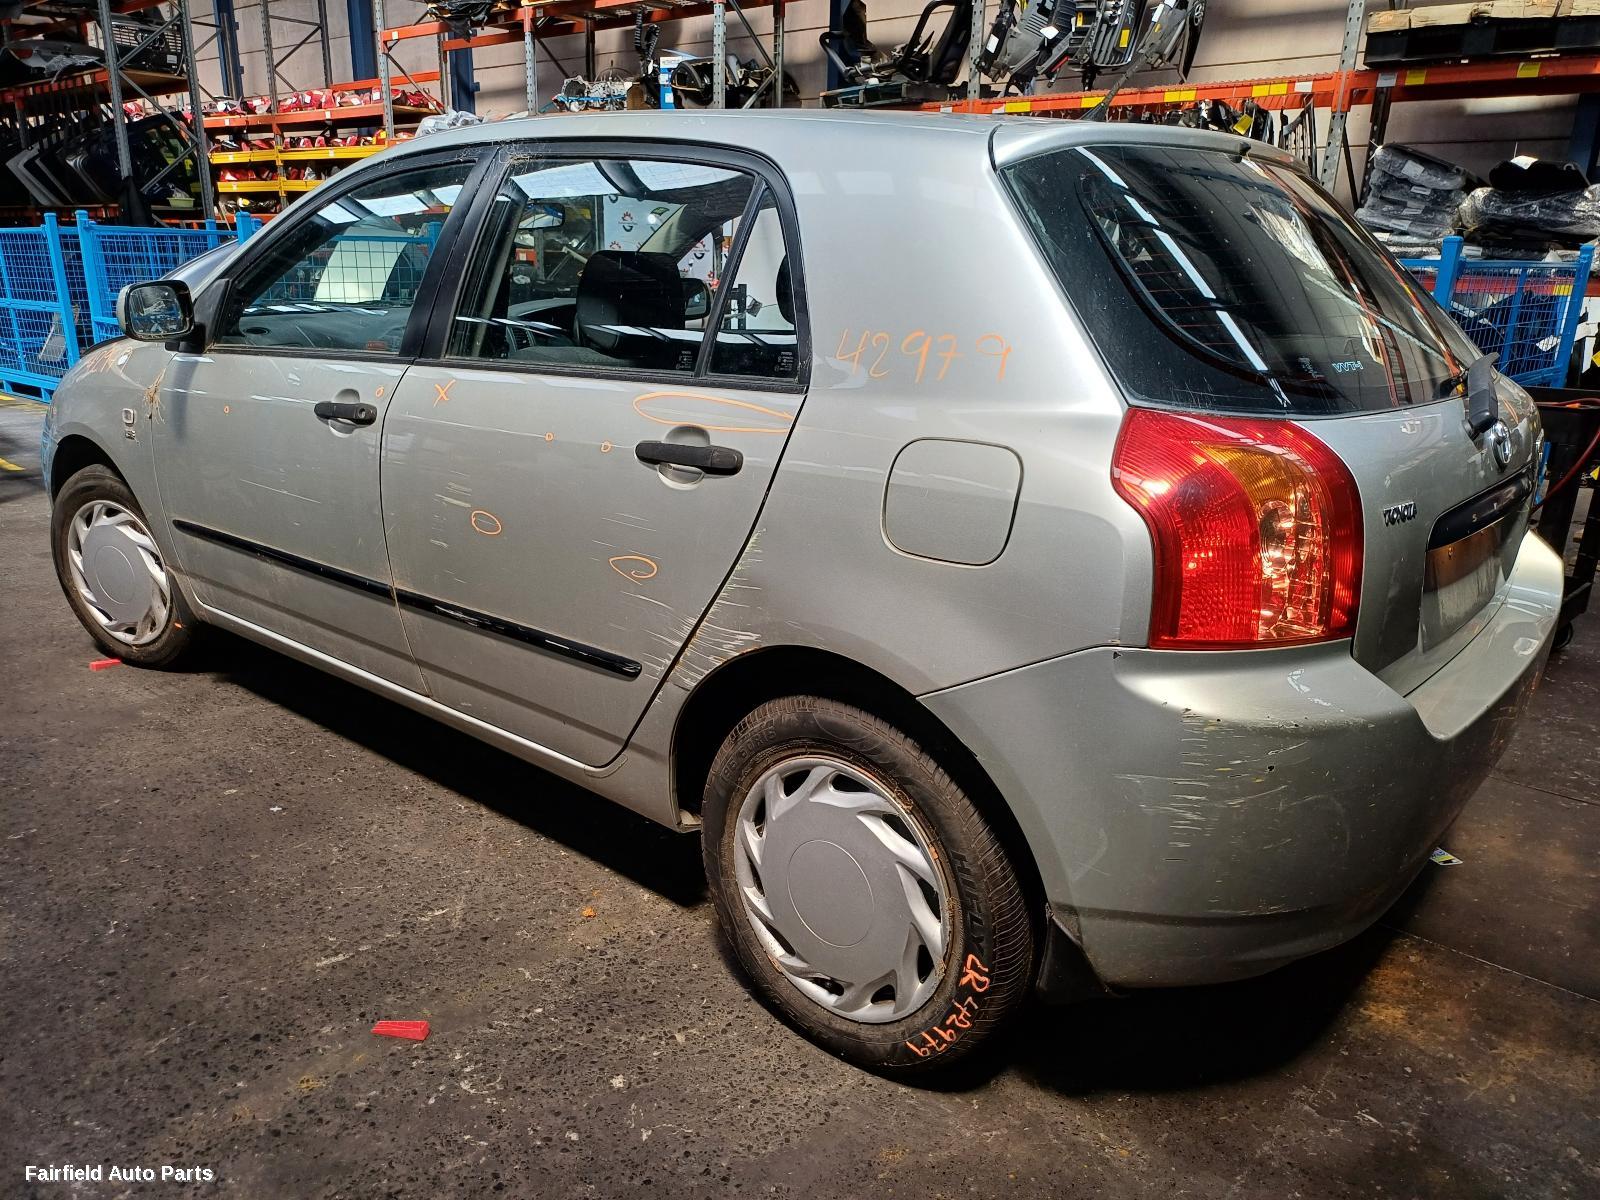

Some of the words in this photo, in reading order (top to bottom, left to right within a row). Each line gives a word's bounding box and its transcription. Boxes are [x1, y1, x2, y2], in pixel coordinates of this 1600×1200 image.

[835, 328, 1013, 385] 42979
[1383, 501, 1418, 527] TOYOTA
[959, 953, 990, 993] LR
[905, 996, 979, 1057] 42979
